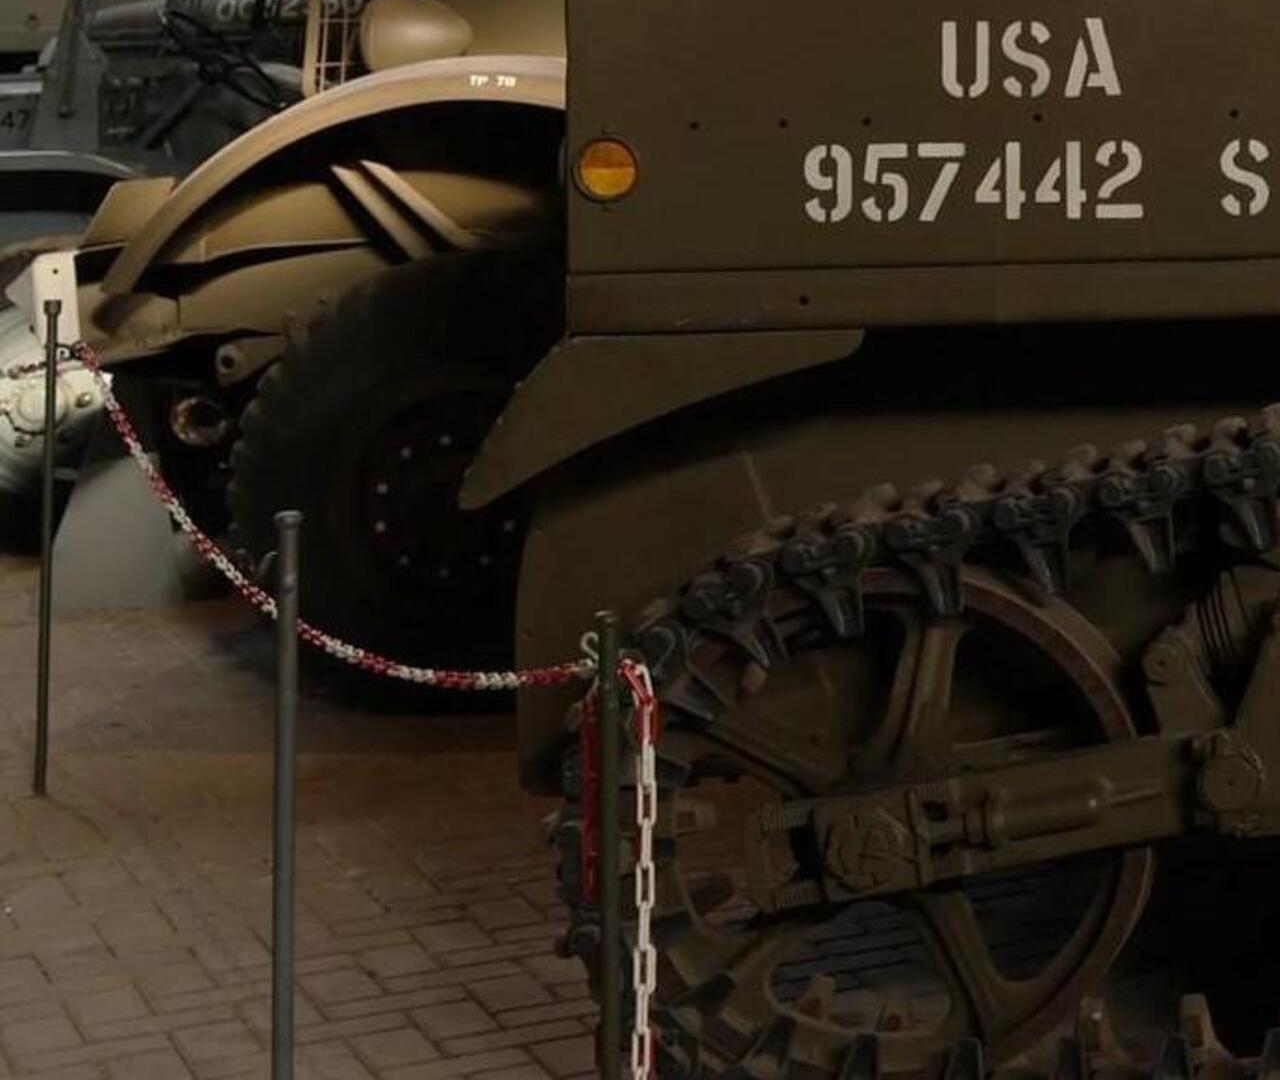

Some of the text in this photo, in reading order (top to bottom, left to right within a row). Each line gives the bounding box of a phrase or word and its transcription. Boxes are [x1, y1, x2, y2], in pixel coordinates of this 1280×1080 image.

[941, 17, 1122, 99] USA
[803, 139, 1271, 223] 957442 S
